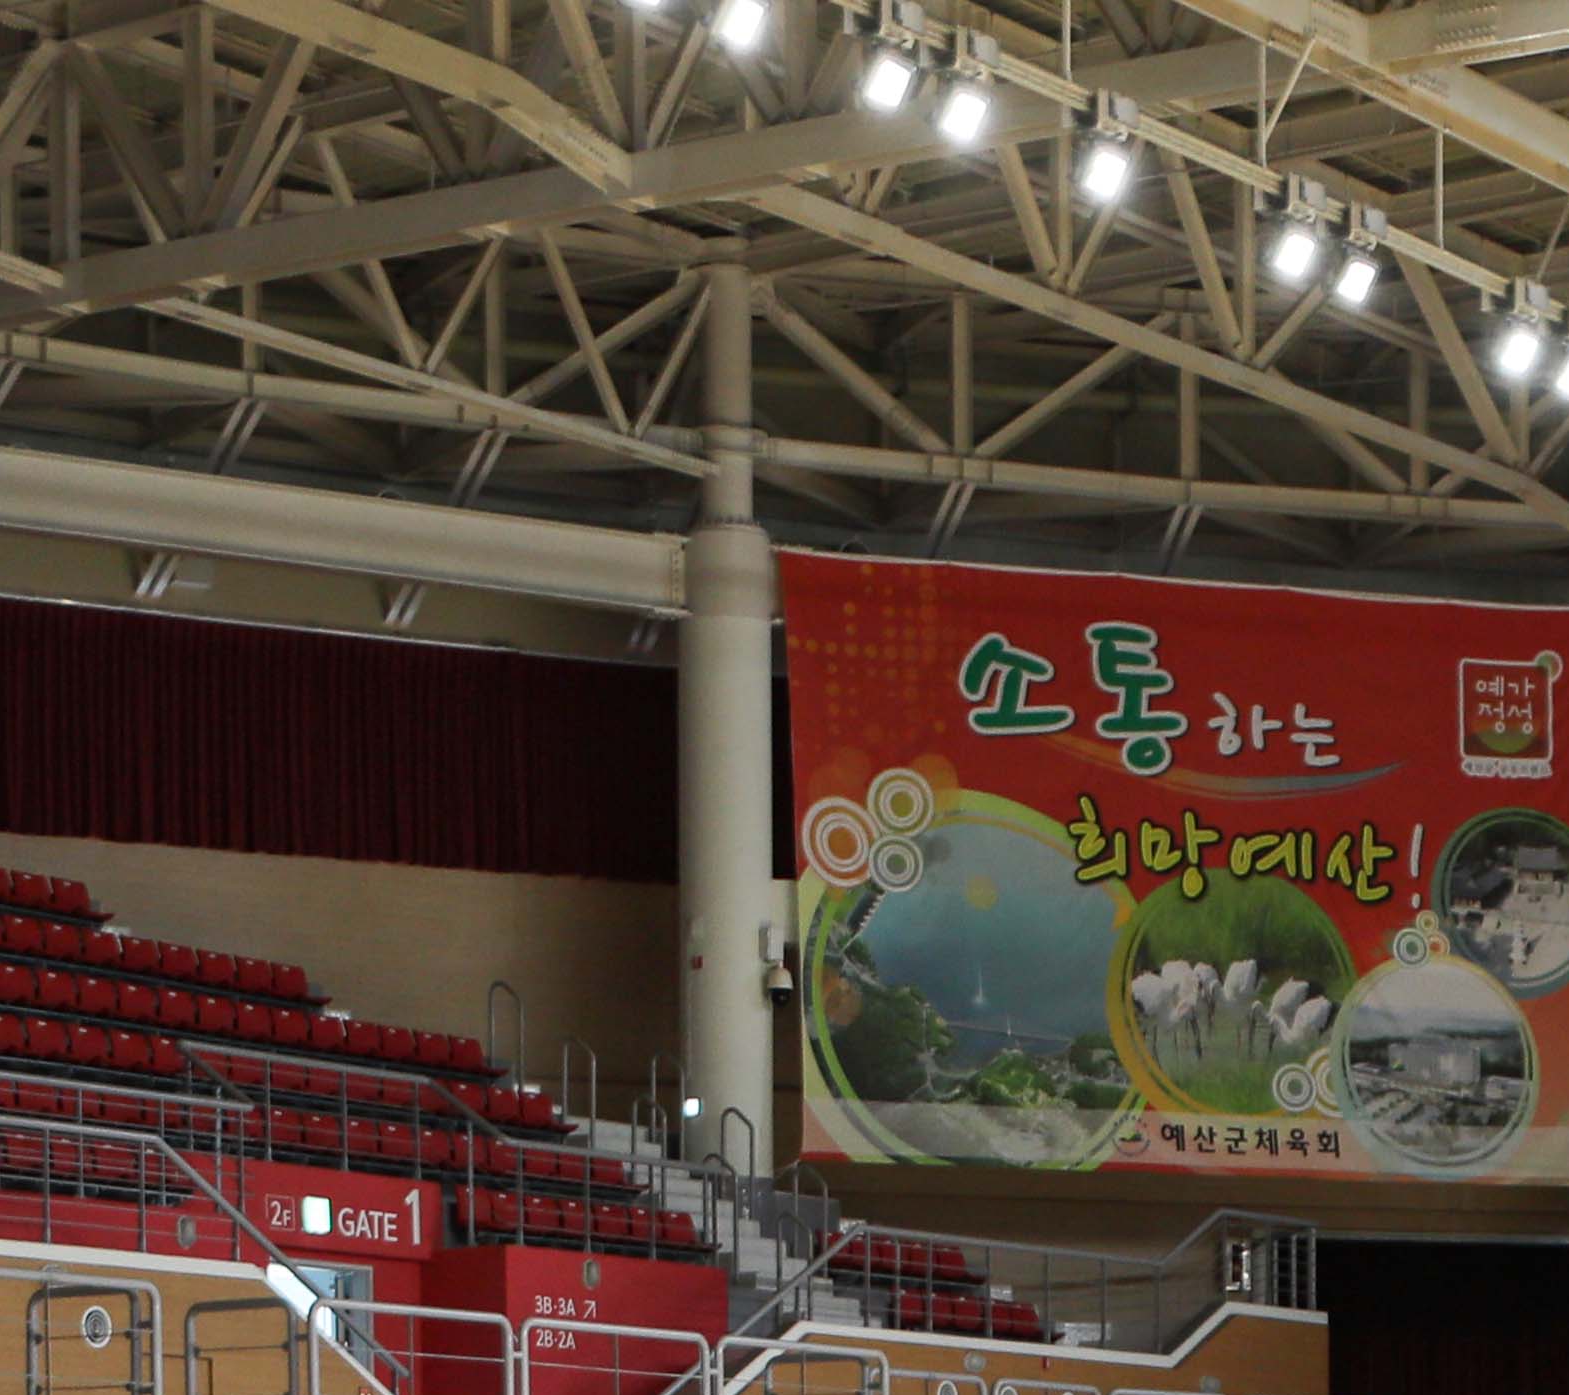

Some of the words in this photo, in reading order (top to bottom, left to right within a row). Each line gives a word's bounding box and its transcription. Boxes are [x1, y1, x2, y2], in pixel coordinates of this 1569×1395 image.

[959, 621, 1341, 776] 소통하는
[1475, 675, 1536, 698] 예가
[1477, 700, 1535, 735] 정성
[1160, 1122, 1341, 1159] 예산군체육회
[270, 1200, 292, 1227] 2F
[337, 1206, 399, 1242] GATE
[404, 1188, 422, 1246] 1
